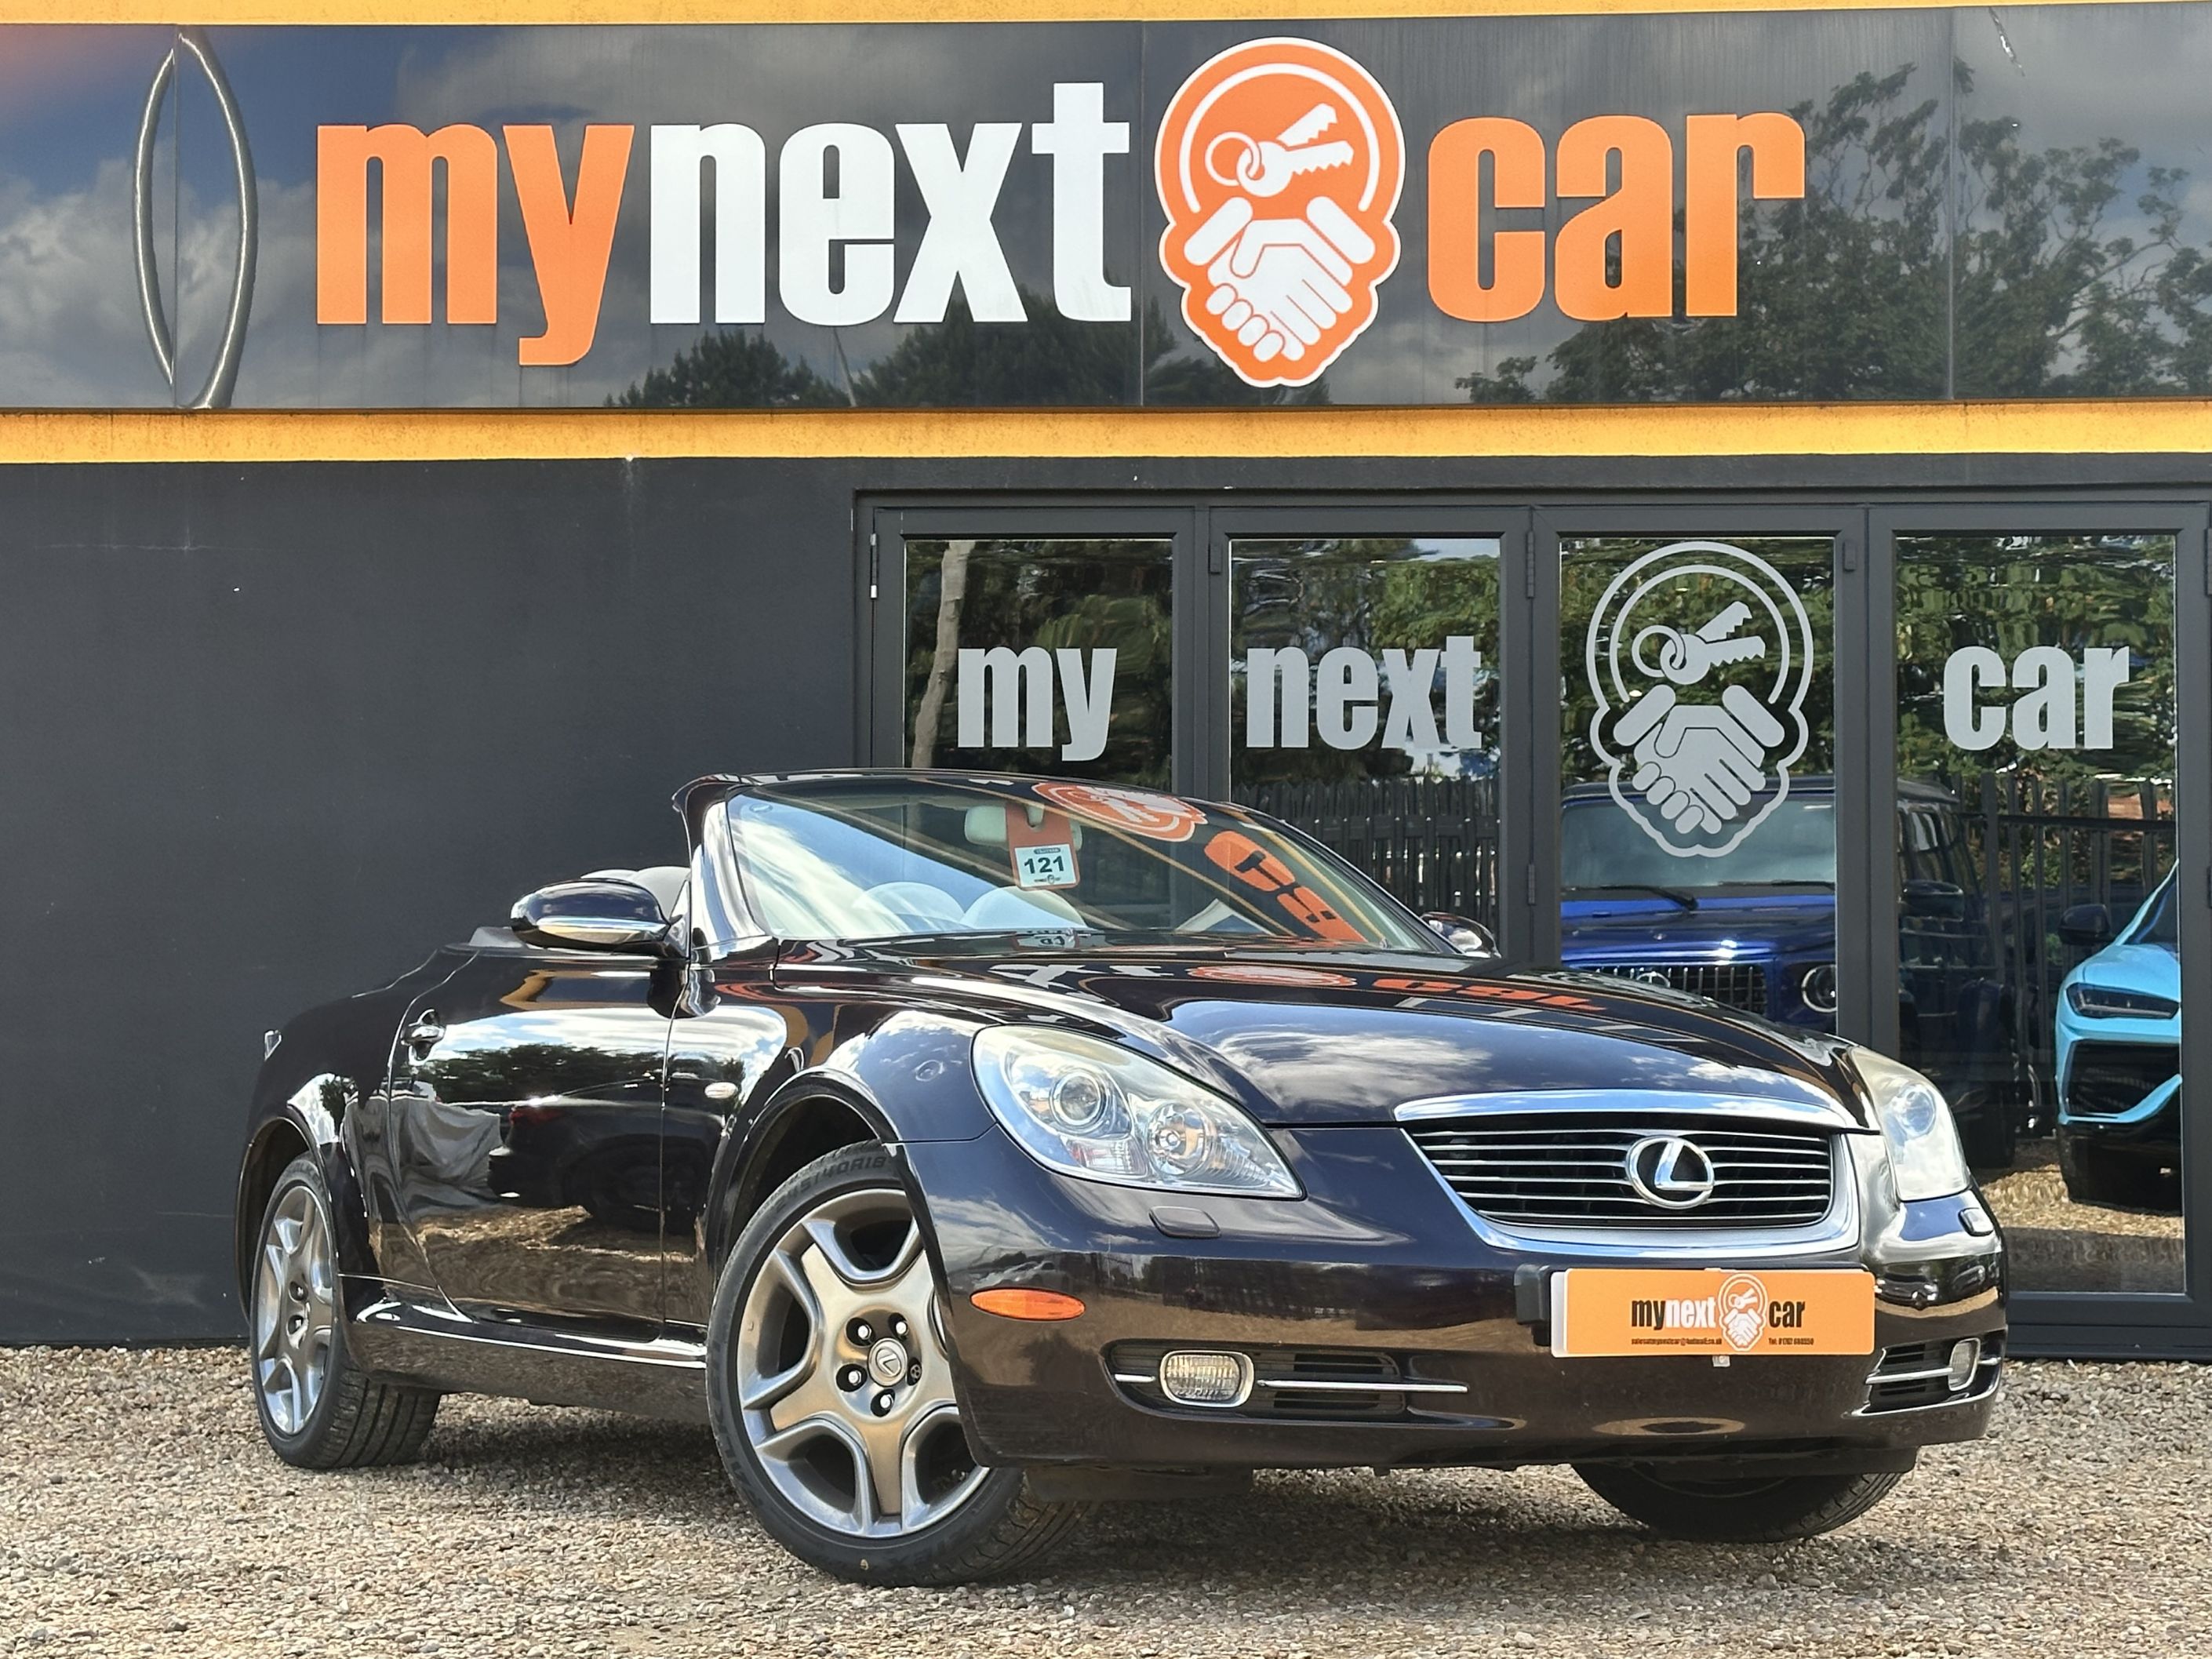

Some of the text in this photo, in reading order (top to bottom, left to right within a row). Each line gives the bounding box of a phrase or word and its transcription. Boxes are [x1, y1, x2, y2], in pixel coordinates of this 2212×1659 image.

[1428, 112, 1806, 322] car
[958, 635, 2130, 762] my next car
[1024, 855, 1064, 875] 121
[1768, 1301, 1806, 1328] car
